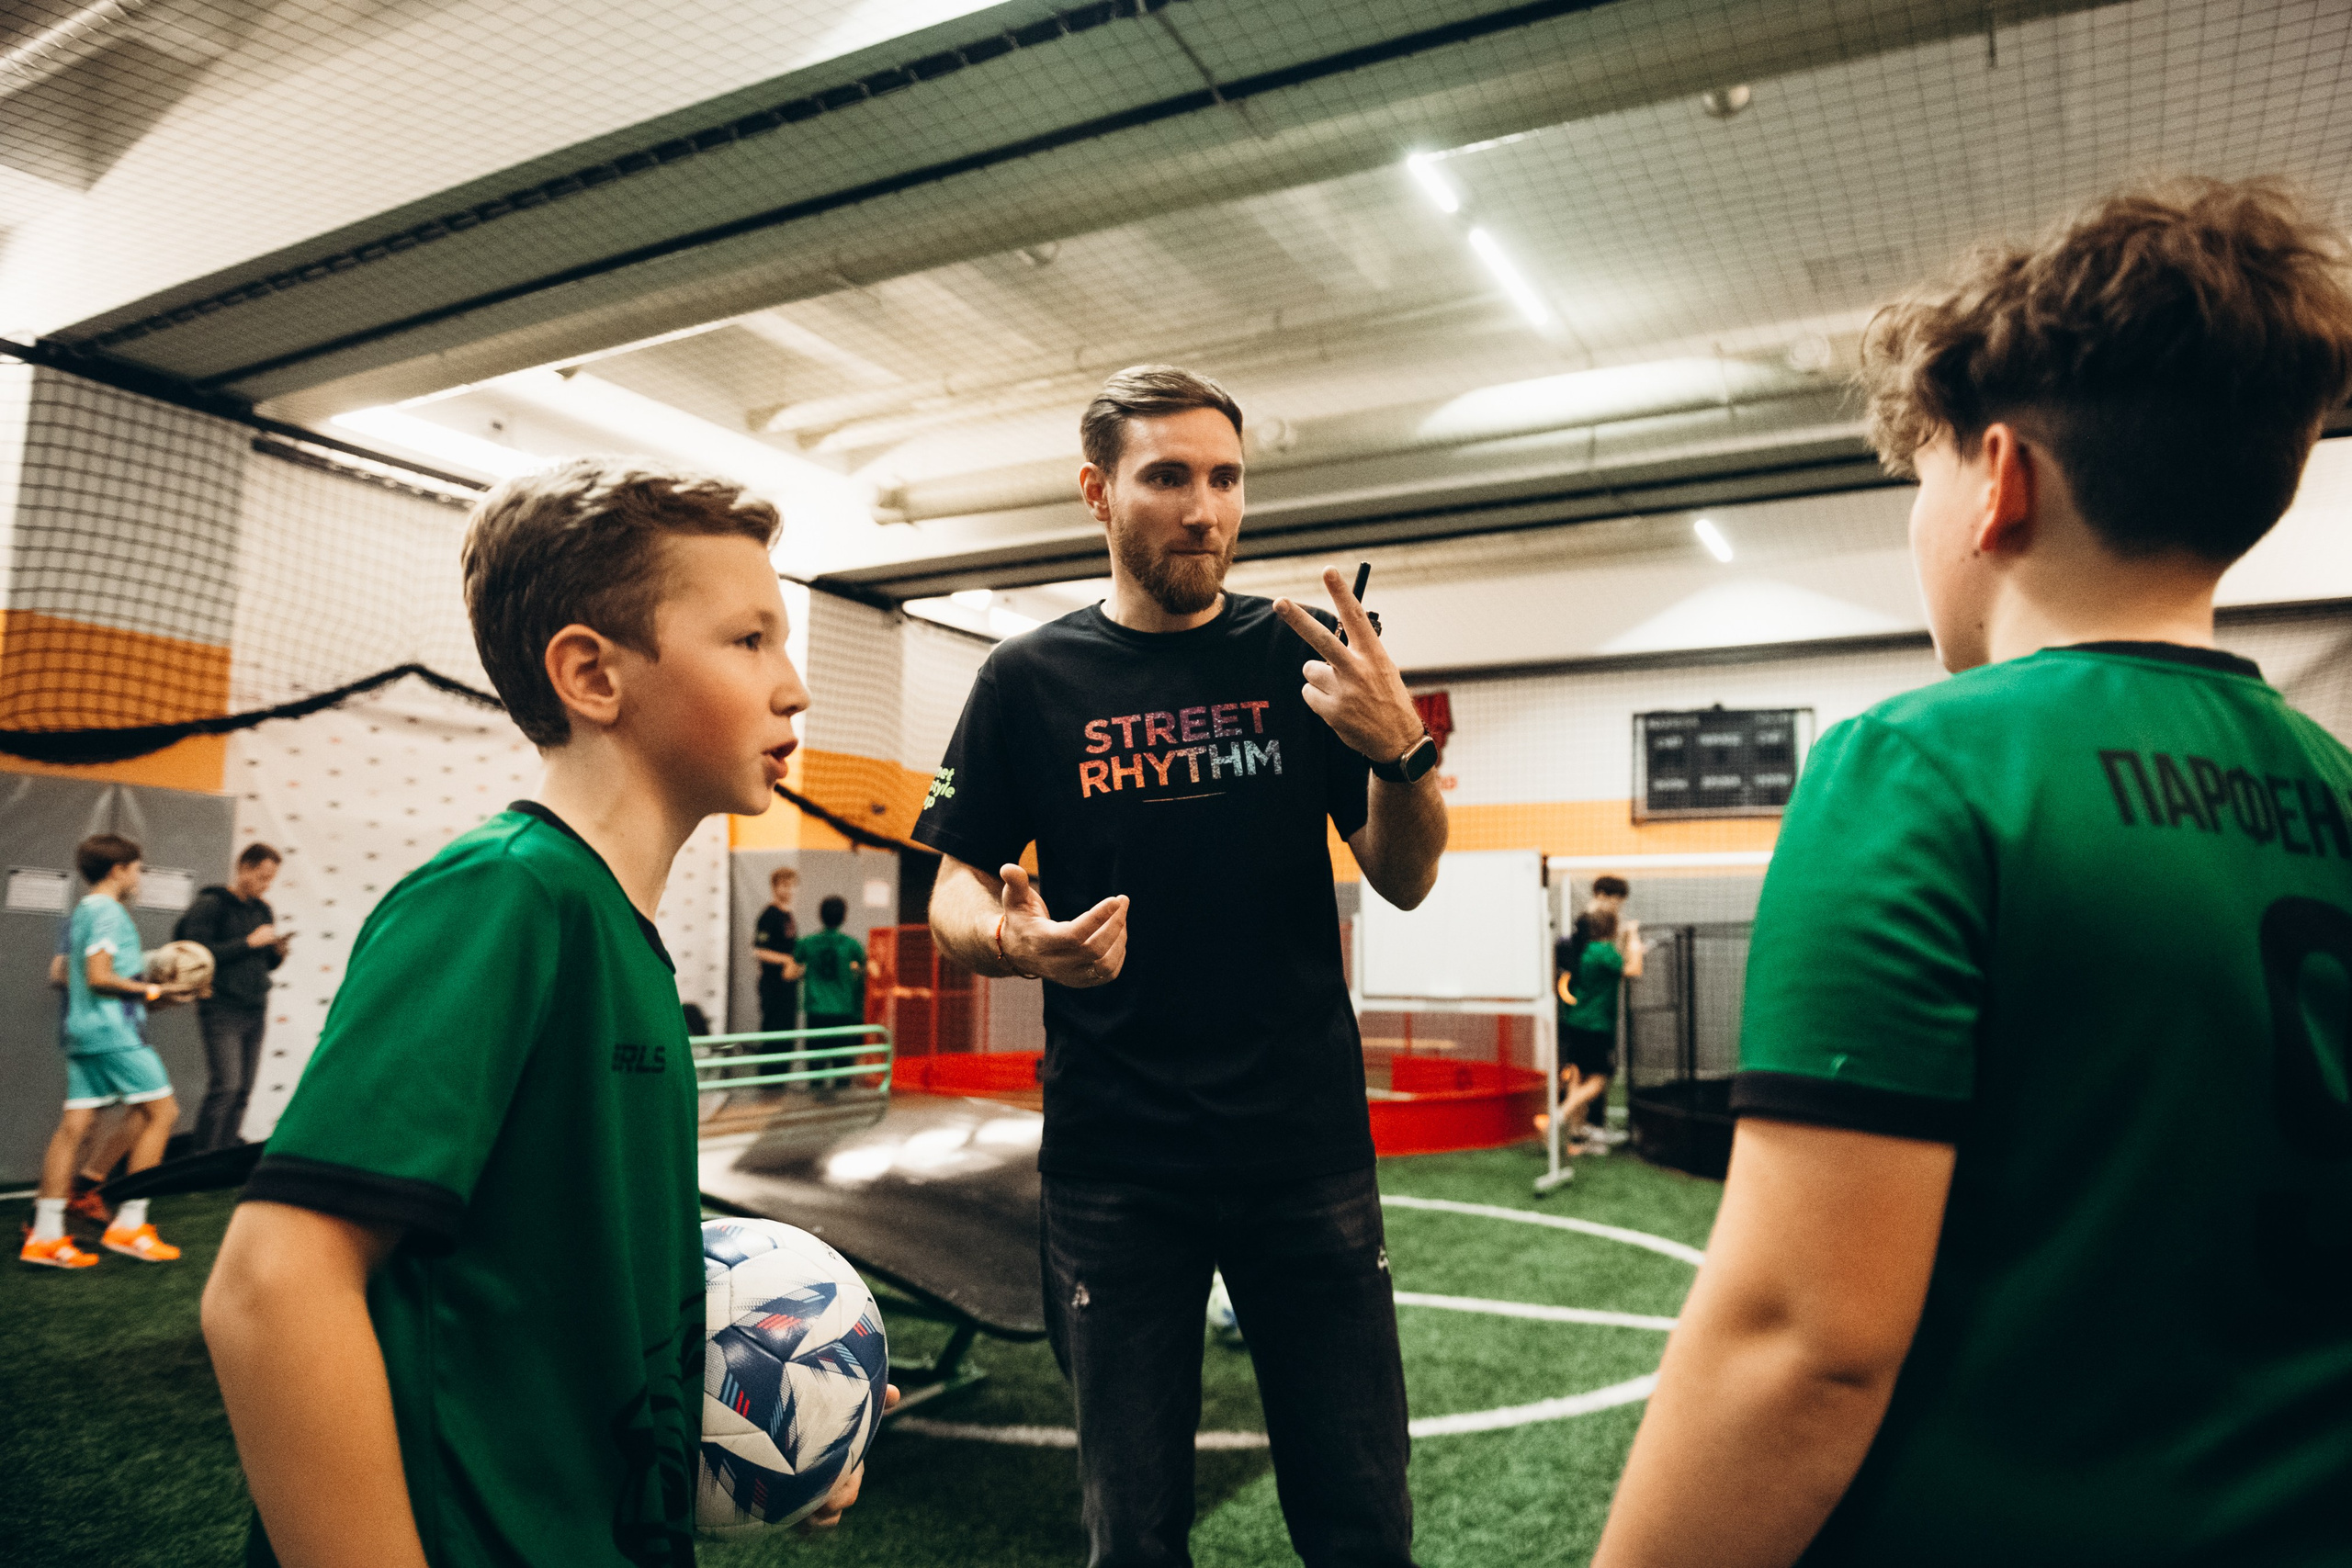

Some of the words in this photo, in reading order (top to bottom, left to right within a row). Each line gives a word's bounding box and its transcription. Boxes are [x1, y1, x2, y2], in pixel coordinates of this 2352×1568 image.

[1084, 700, 1270, 754] STREET
[1079, 739, 1283, 798] RHYTHM
[2098, 749, 2352, 859] ПАРФЕН
